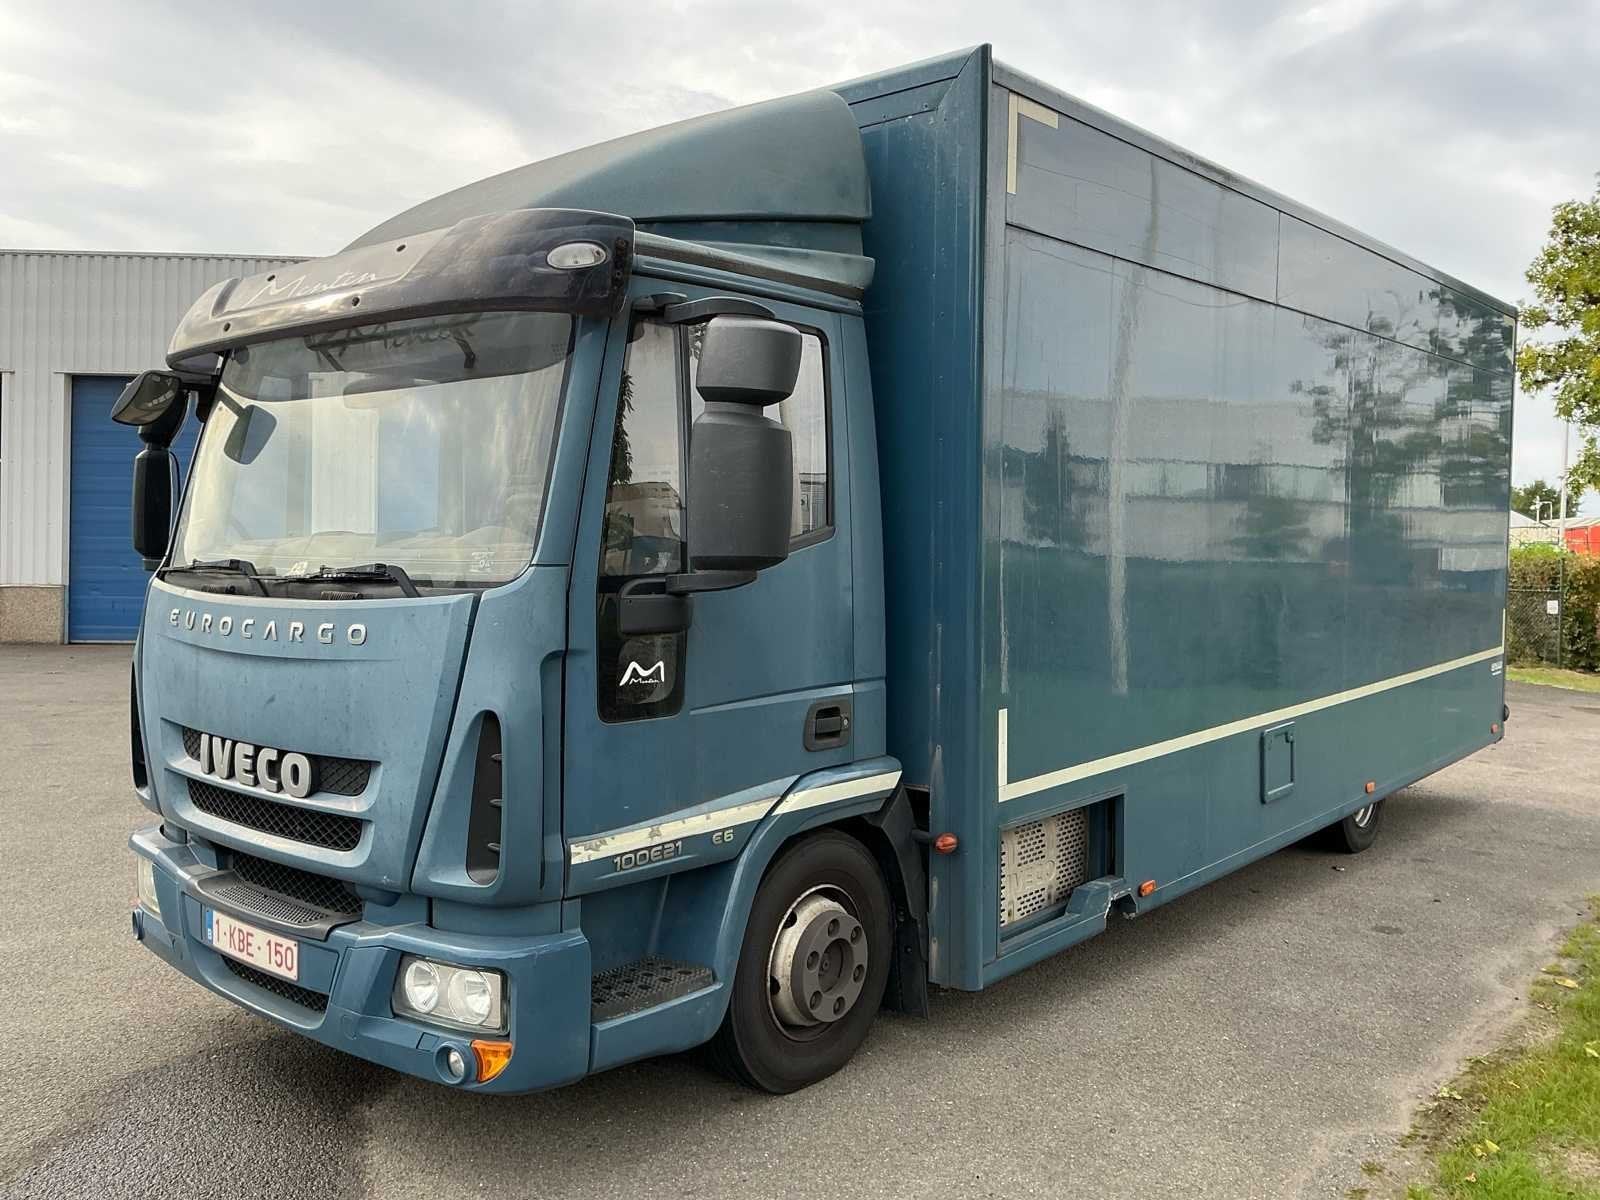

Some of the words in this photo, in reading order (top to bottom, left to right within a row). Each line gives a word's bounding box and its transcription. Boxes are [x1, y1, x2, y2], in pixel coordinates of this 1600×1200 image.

[169, 608, 367, 646] EUROCARGO
[199, 733, 312, 798] IVECO
[613, 840, 682, 872] 100E21
